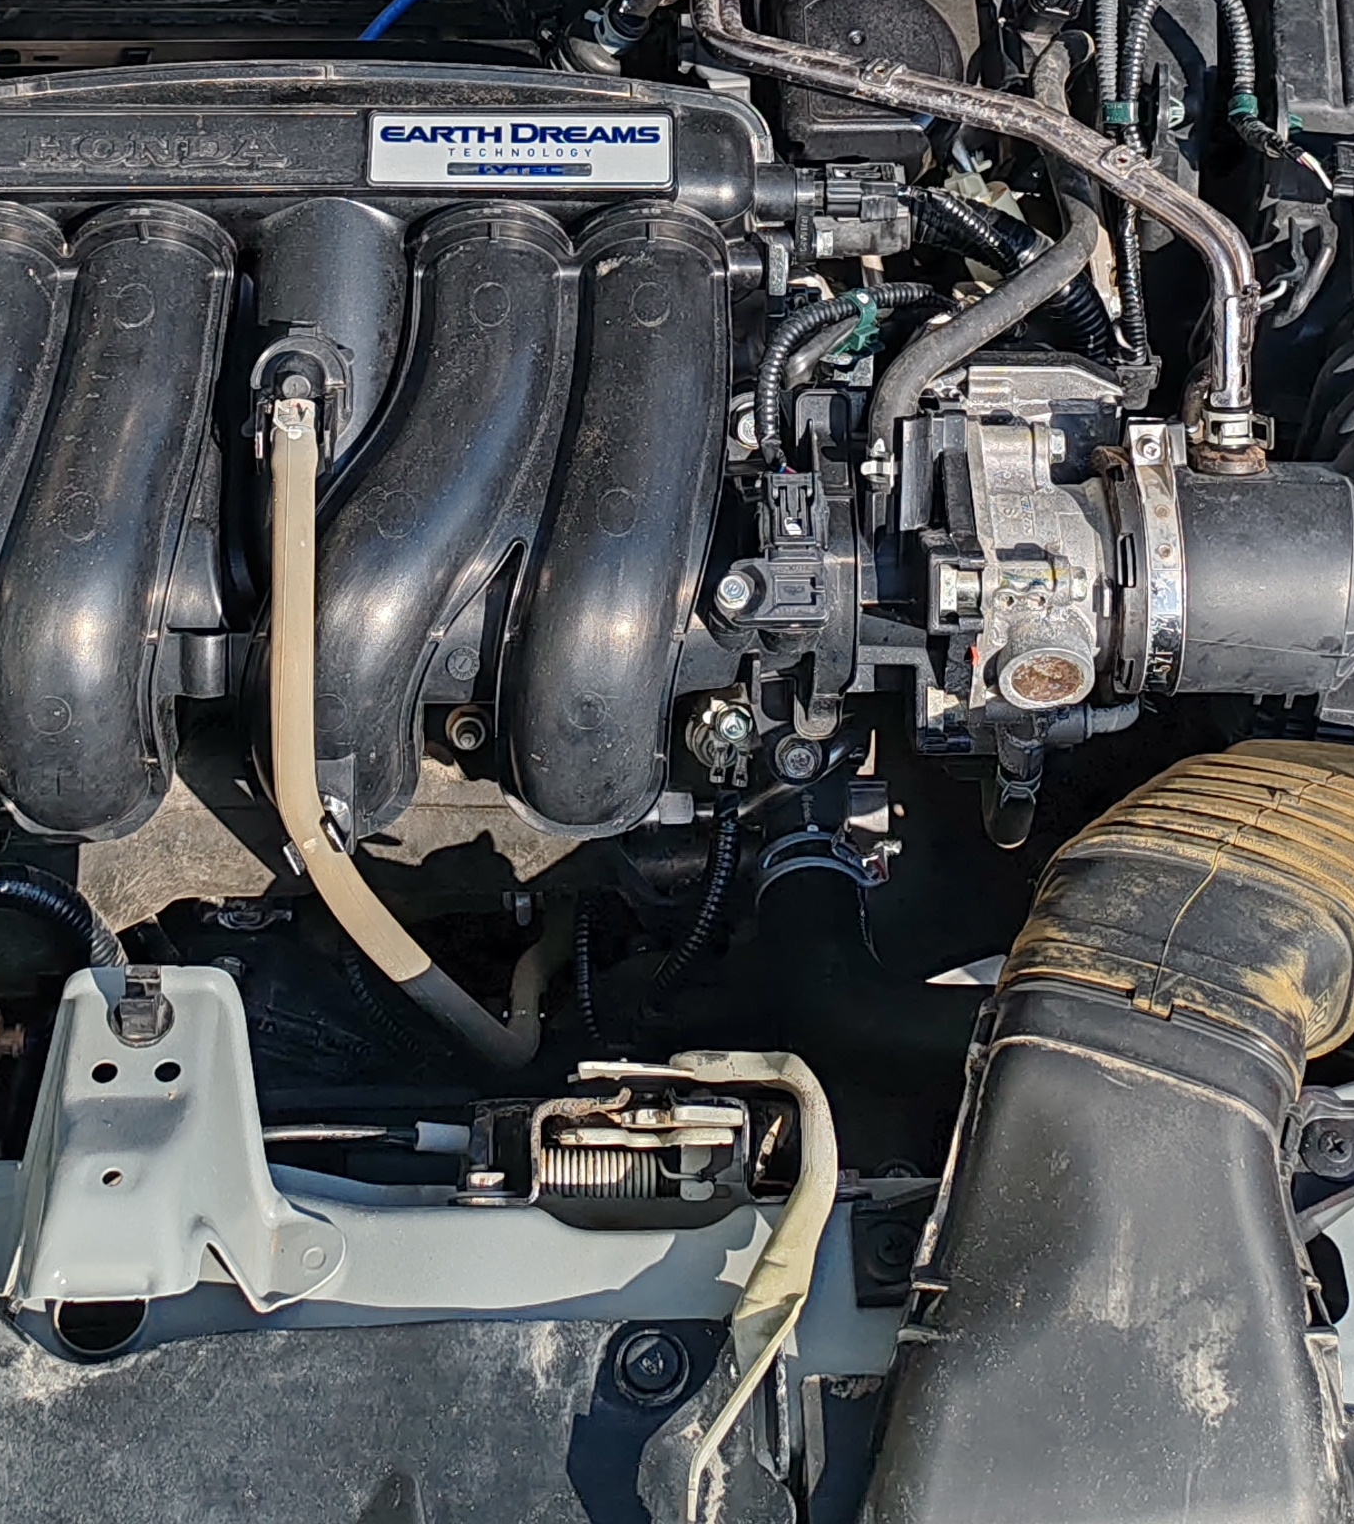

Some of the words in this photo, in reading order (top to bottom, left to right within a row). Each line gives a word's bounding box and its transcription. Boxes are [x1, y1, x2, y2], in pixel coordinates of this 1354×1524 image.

[380, 125, 503, 144] EARTH
[510, 122, 661, 144] DREAMS
[20, 131, 292, 168] HONDA
[447, 147, 593, 158] TECHNOLOGY
